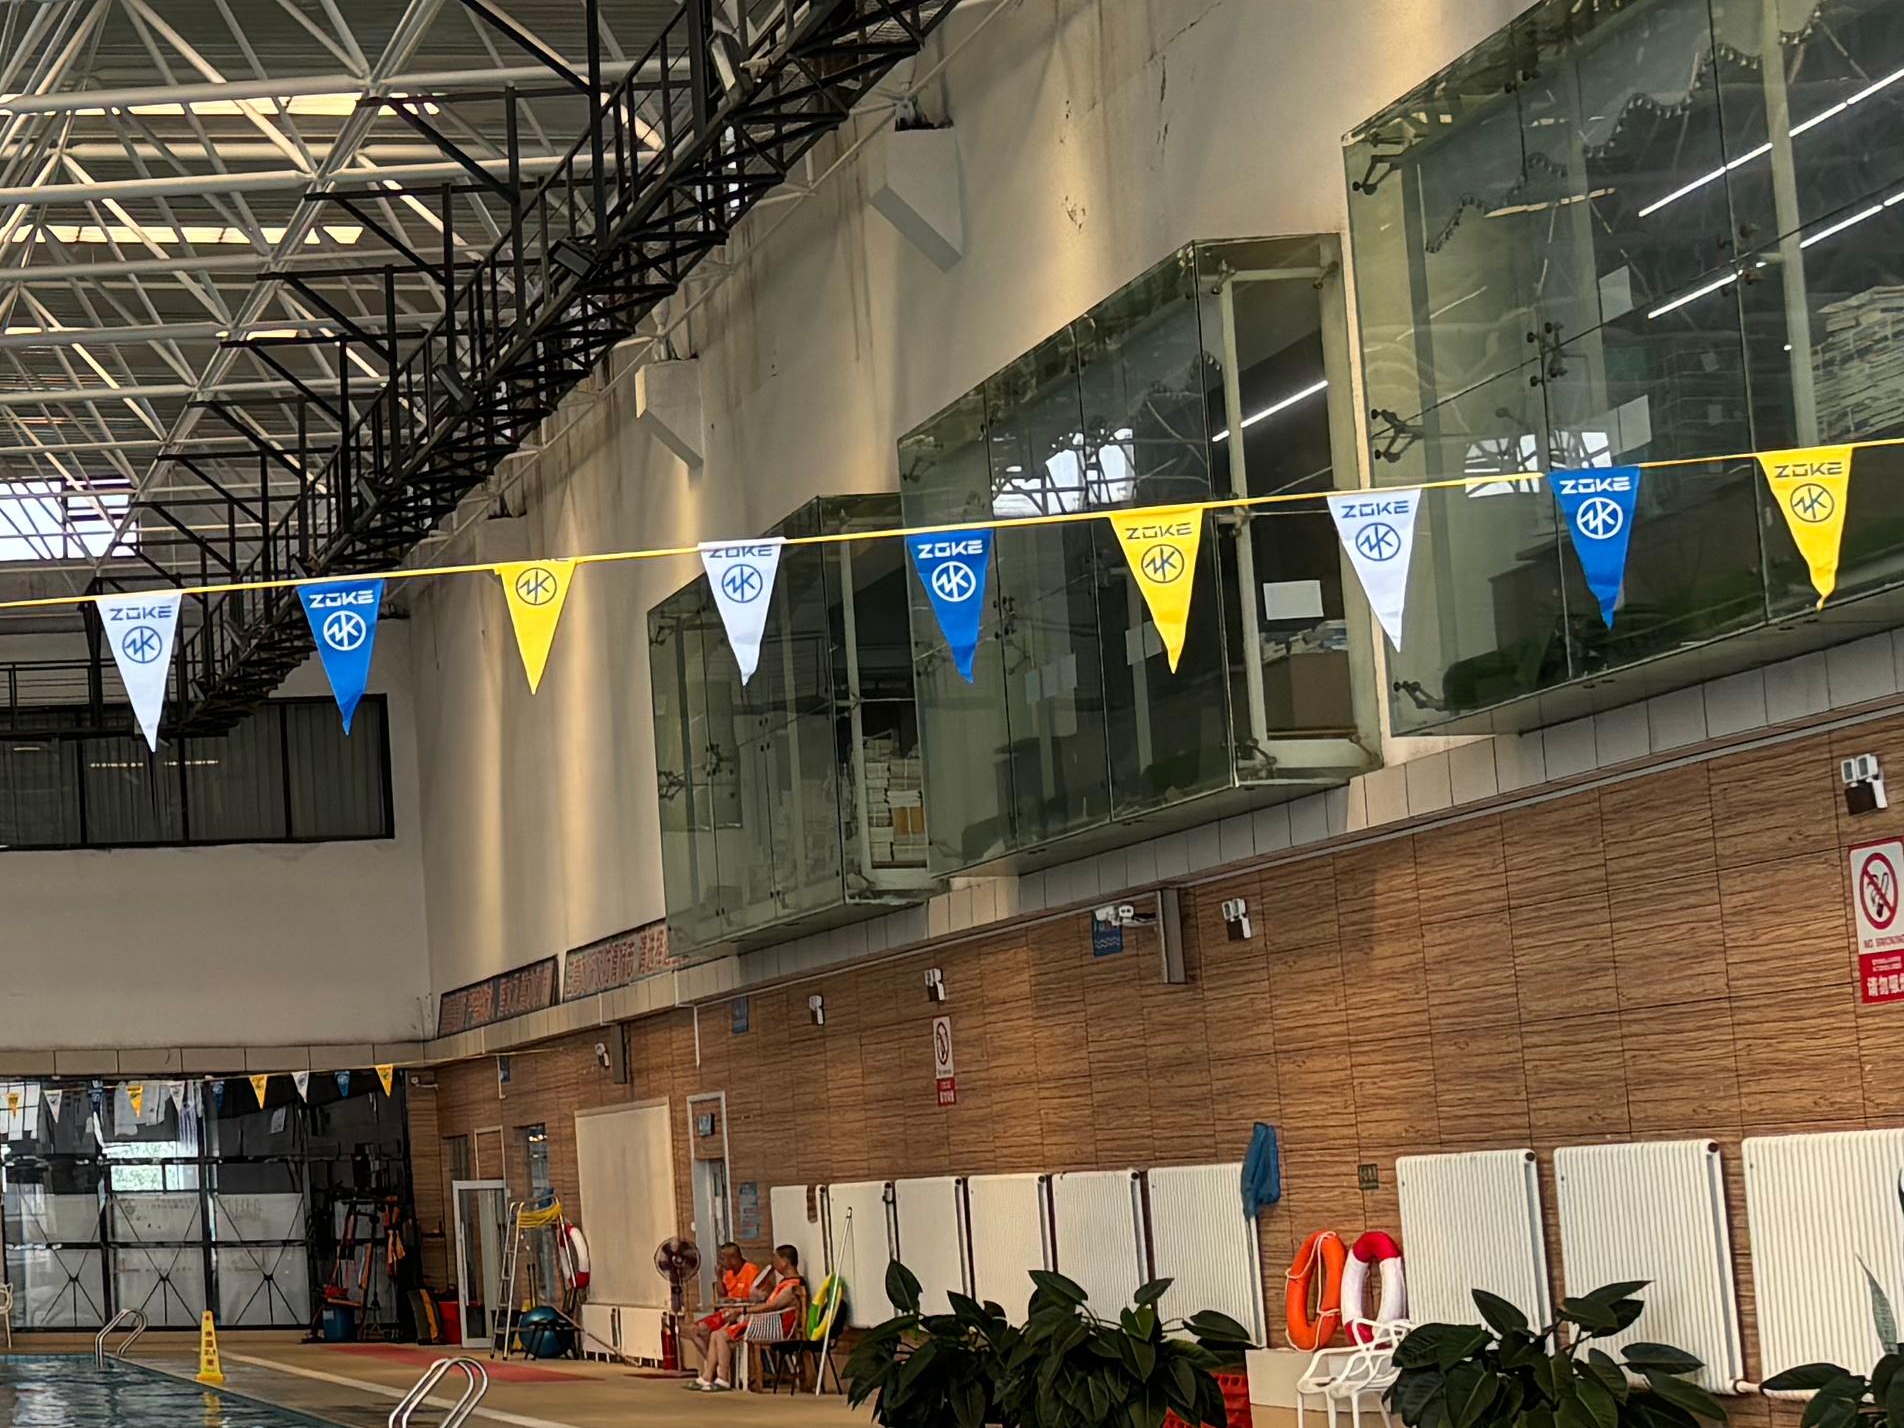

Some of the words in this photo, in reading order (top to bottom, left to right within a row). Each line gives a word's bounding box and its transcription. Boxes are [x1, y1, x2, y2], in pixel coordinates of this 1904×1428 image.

[1773, 461, 1844, 478] ZOKE
[1559, 477, 1630, 494] ZOKE
[1340, 500, 1410, 518] ZOKE
[1124, 523, 1191, 539] ZOKE
[917, 543, 983, 558] ZOKE
[309, 590, 374, 607] ZOKE
[109, 605, 172, 621] ZOKE
